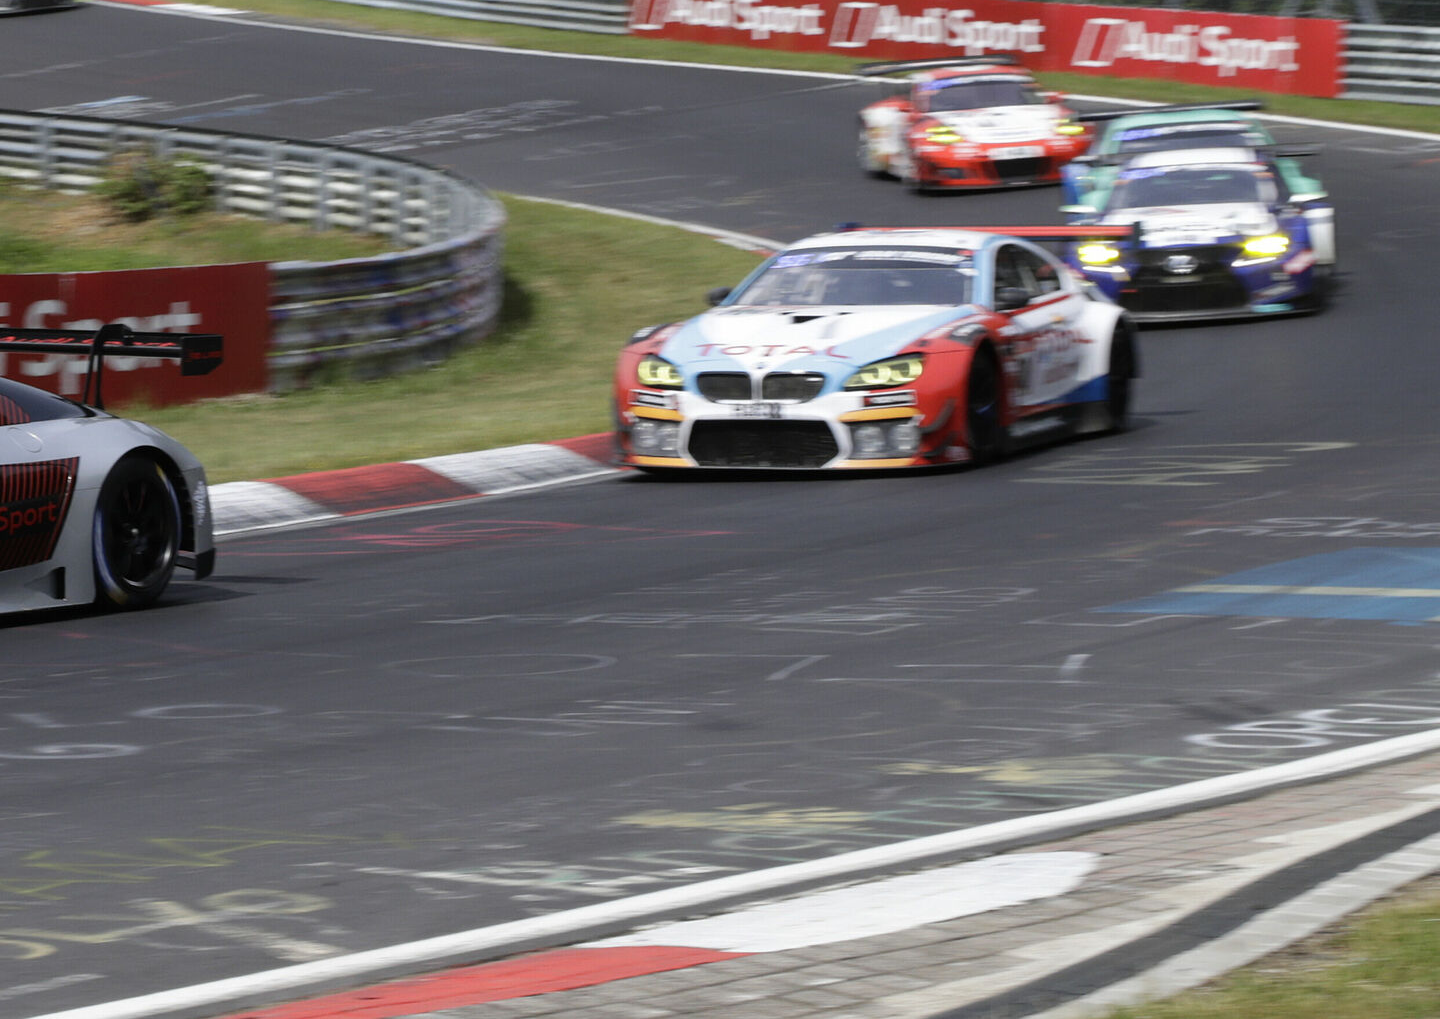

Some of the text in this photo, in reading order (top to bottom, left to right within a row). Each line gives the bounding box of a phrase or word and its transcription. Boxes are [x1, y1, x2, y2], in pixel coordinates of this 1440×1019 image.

[872, 4, 1046, 56] Audi Sport
[1121, 20, 1300, 77] Audi Sport
[695, 343, 852, 359] TOTAL
